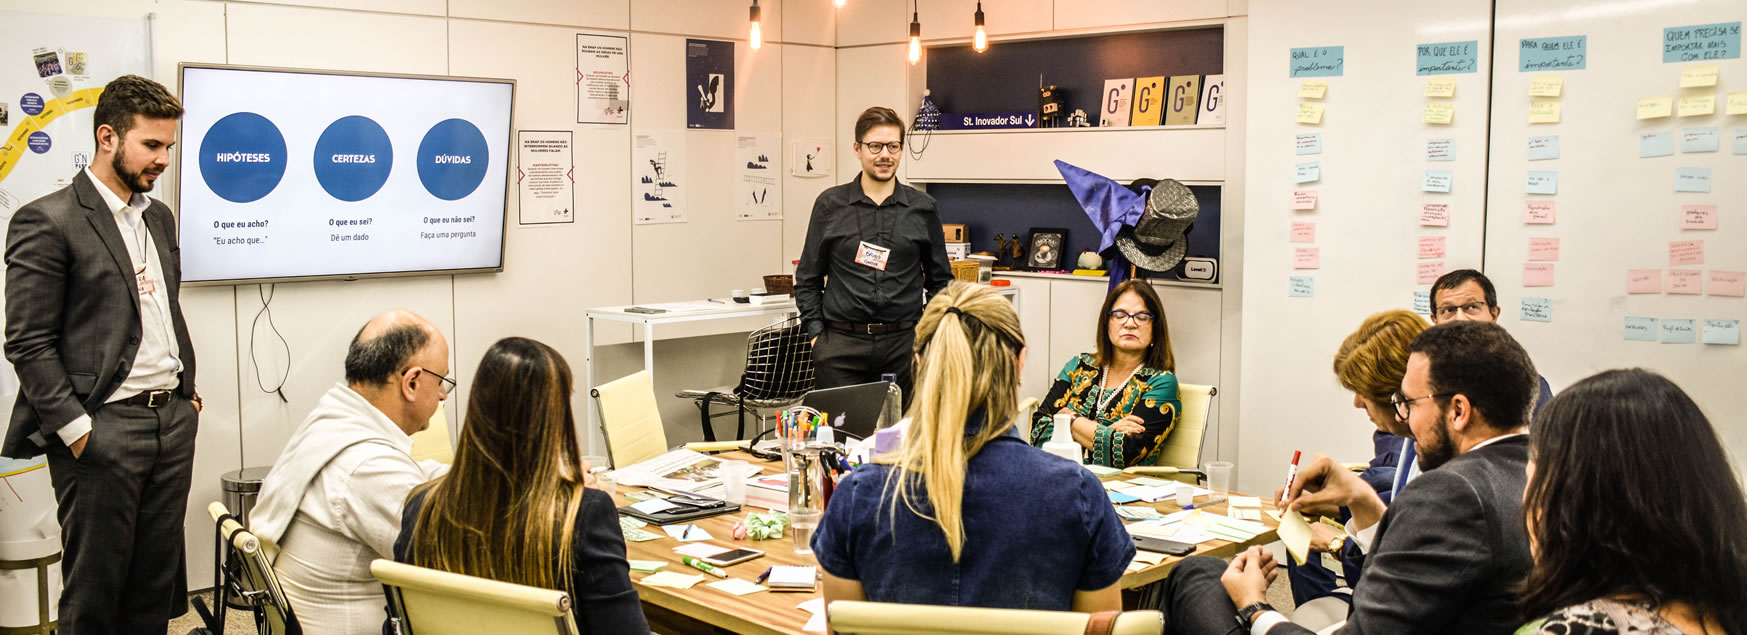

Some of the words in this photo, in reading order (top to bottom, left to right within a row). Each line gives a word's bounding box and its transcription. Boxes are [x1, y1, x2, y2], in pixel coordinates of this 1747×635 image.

[1666, 30, 1690, 42] QUEM
[1694, 27, 1727, 40] PRECISA
[1729, 25, 1740, 36] SE
[1521, 39, 1538, 49] PARA
[1562, 41, 1574, 51] ELE
[1665, 41, 1704, 53] IMPORTAR
[1707, 40, 1726, 49] MAIS
[1292, 51, 1310, 60] QUAL
[1417, 47, 1431, 57] POR
[1433, 46, 1447, 57] QUE
[1449, 46, 1461, 56] ELE
[1680, 52, 1699, 61] COM
[1703, 50, 1727, 60] ELE?
[963, 116, 974, 126] St.
[975, 116, 1009, 126] Inovador
[1010, 115, 1023, 125] Sul
[216, 151, 271, 164] HIPÓTESES
[331, 154, 376, 165] CERTEZAS
[435, 154, 471, 165] DÚVIDAS
[213, 220, 220, 229] O
[221, 221, 236, 231] que
[236, 222, 246, 230] eu
[247, 219, 269, 229] acho?
[328, 219, 335, 227] O
[336, 220, 348, 228] que
[349, 219, 358, 227] eu
[359, 218, 373, 227] sei?
[423, 217, 429, 225] O
[430, 218, 441, 227] que
[450, 215, 462, 225] não
[463, 215, 476, 224] sei?
[213, 236, 226, 246] "Eu
[227, 236, 245, 246] acho
[330, 233, 340, 243] Dê
[352, 233, 369, 242] dado
[420, 231, 435, 241] Faça
[449, 230, 477, 241] pergunta
